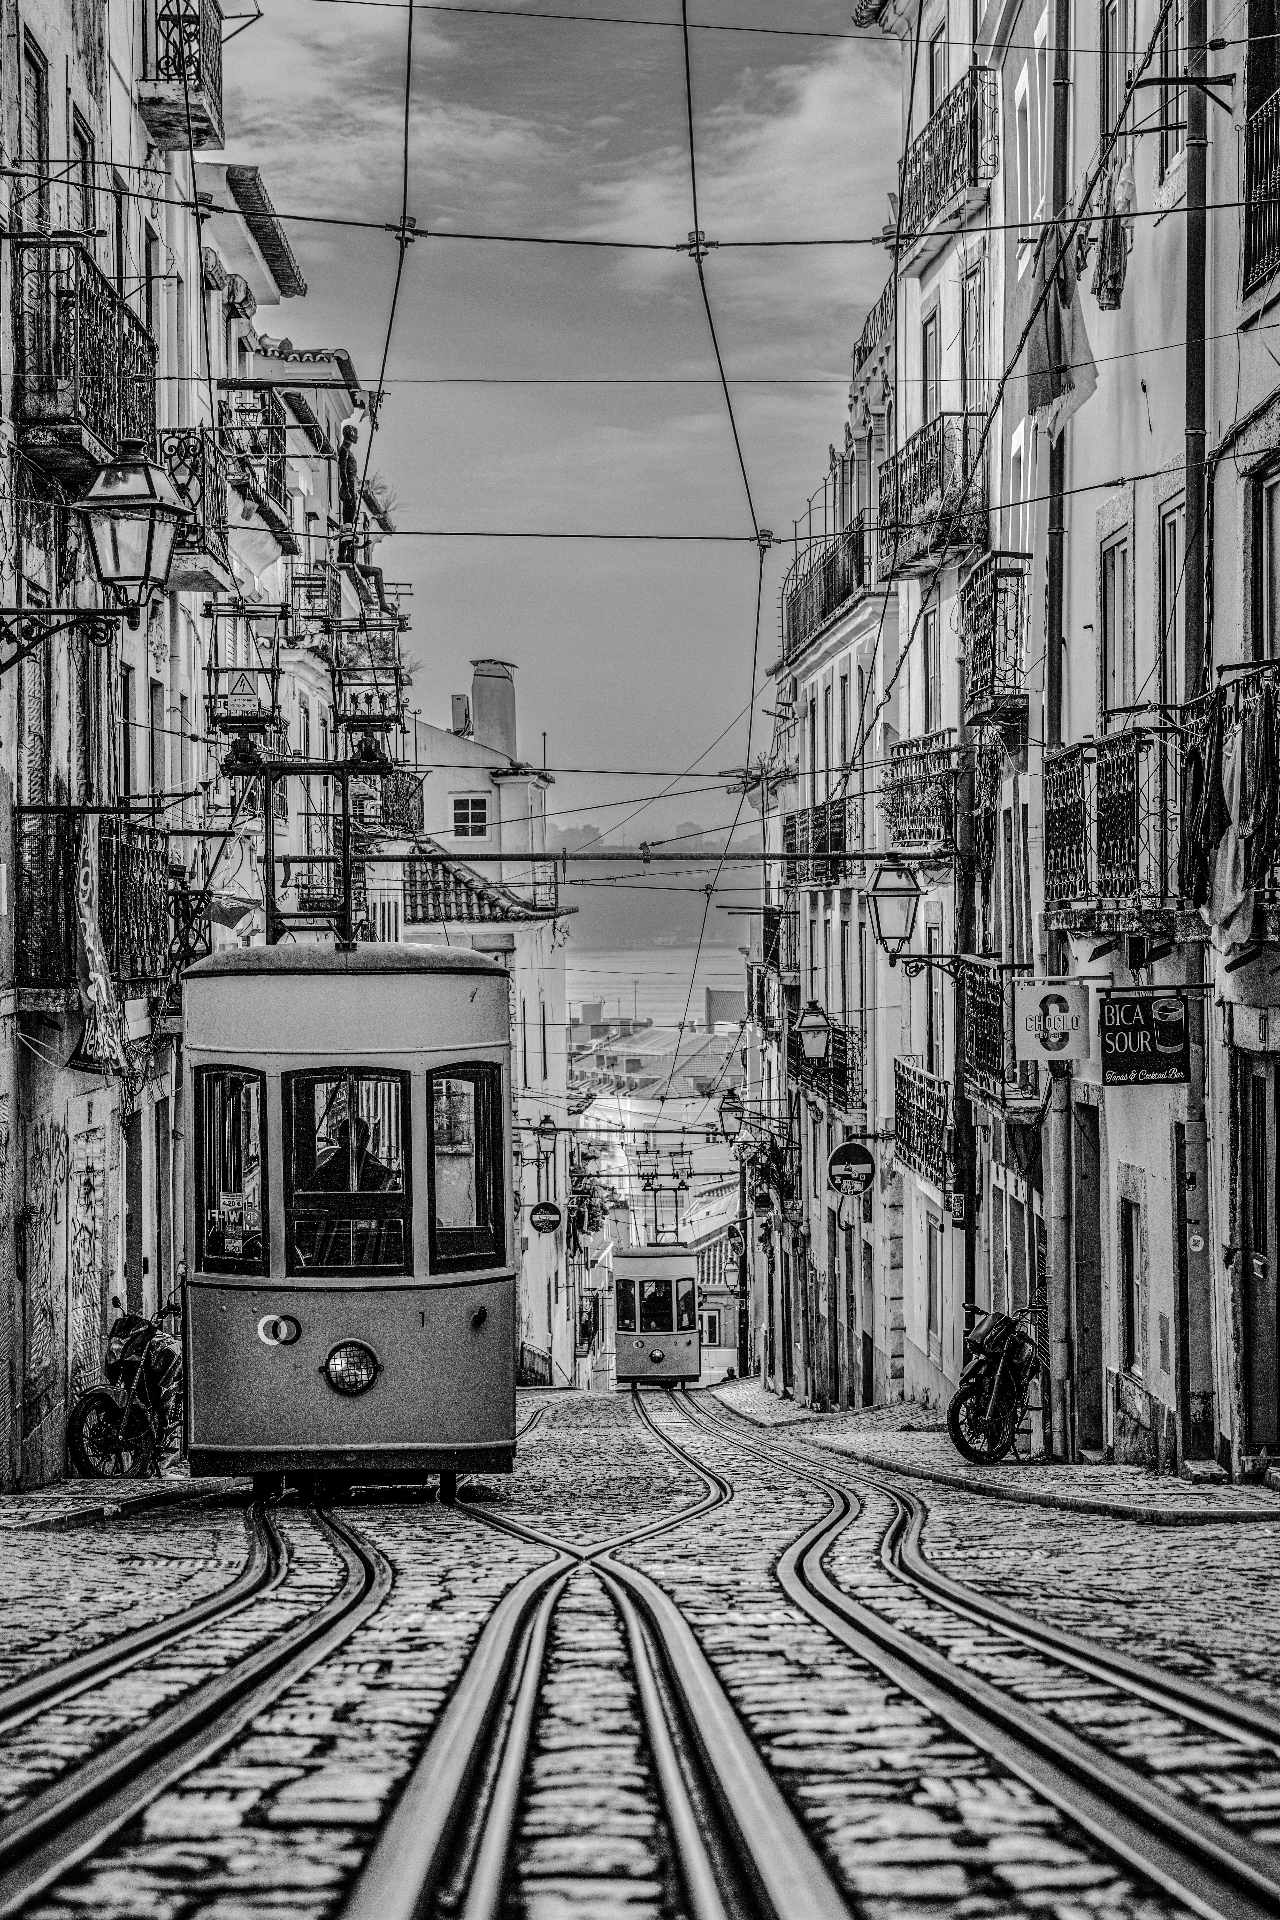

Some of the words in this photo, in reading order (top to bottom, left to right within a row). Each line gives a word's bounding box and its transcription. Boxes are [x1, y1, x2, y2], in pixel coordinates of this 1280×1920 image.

[1025, 1014, 1081, 1032] CHOCLO
[1104, 1004, 1145, 1026] BICA
[1105, 1030, 1152, 1054] SOUR
[1128, 1069, 1137, 1082] &
[1138, 1069, 1168, 1081] Cocktail
[1167, 1067, 1185, 1080] Bar
